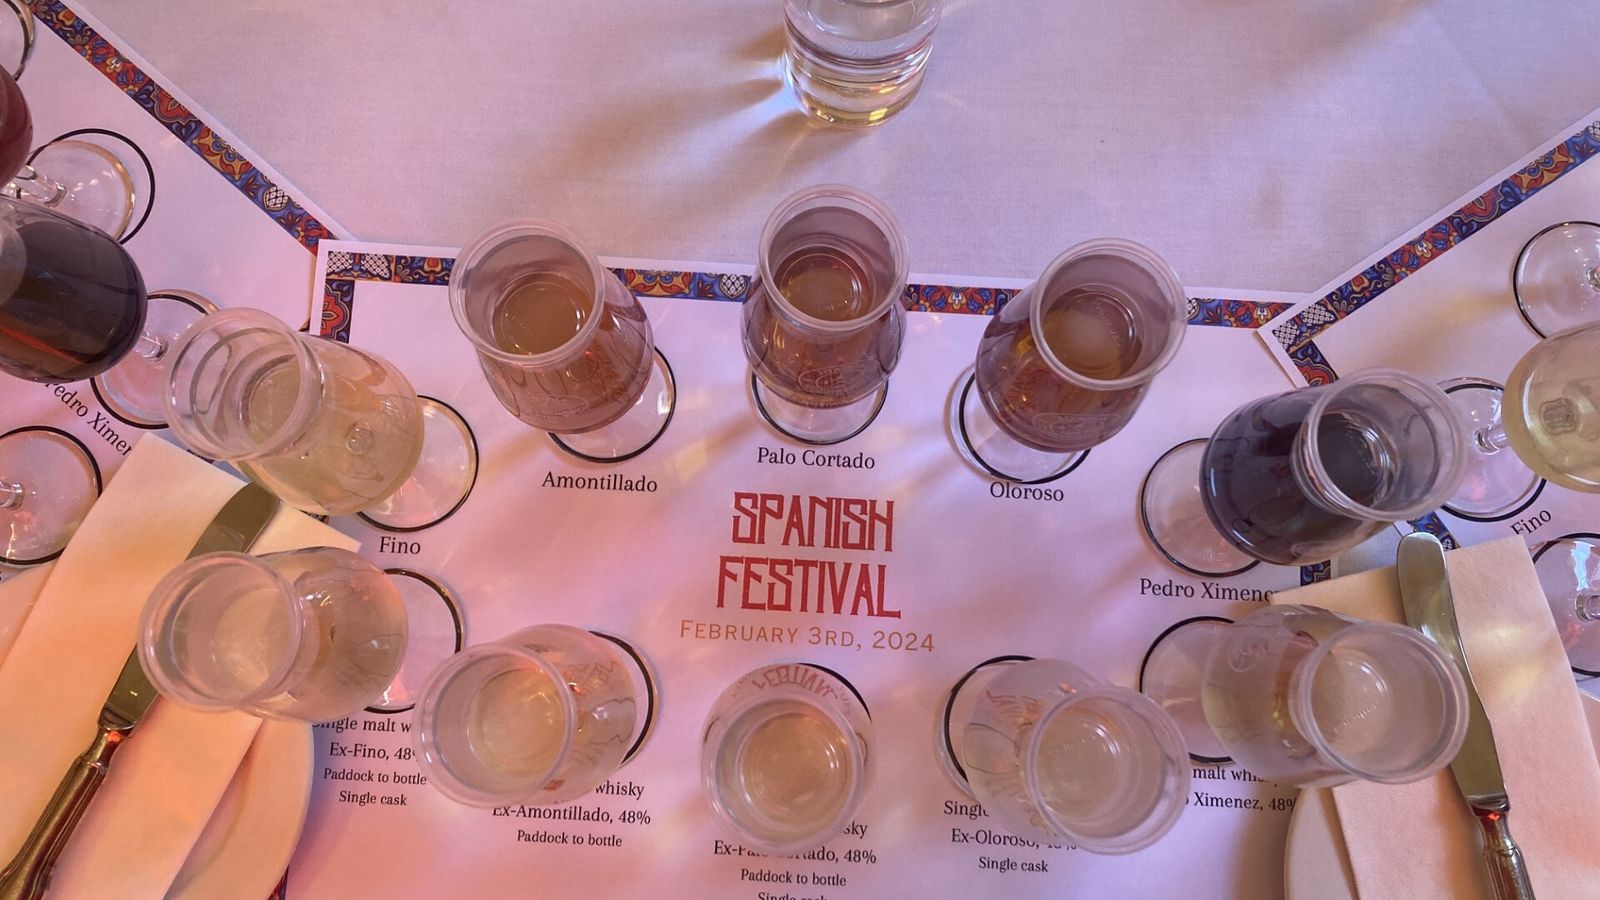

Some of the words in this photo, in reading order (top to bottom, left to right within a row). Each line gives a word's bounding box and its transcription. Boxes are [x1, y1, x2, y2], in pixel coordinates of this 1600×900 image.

[757, 447, 796, 466] Palo
[802, 449, 875, 469] Cortado
[541, 472, 657, 492] Amontillado
[990, 481, 1064, 502] Oloroso
[732, 491, 895, 552] SPANISH
[1510, 509, 1552, 535] Fino
[379, 536, 421, 555] Fino
[716, 555, 902, 619] FESTIVAL
[1140, 578, 1195, 598] Pedro
[1201, 582, 1279, 602] Ximene
[680, 619, 798, 643] FEBRUARY
[808, 626, 862, 651] 3RD,
[872, 630, 935, 652] 2024
[362, 718, 396, 732] malt
[329, 742, 390, 761] Ex-Fino,
[394, 747, 416, 760] 48
[323, 767, 374, 782] Paddock
[377, 772, 389, 783] to
[393, 771, 427, 785] bottle
[1192, 766, 1226, 780] malt
[339, 790, 377, 806] Single
[380, 794, 407, 806] cask
[596, 780, 645, 800] whisky
[1193, 792, 1263, 811] Ximenez,
[618, 809, 651, 825] 48%
[517, 830, 569, 844] Paddock
[572, 834, 584, 845] to
[588, 833, 622, 847] bottle
[843, 849, 877, 864] 48%
[978, 856, 1017, 873] Single
[1021, 860, 1048, 872] cask
[741, 868, 792, 884] Paddock
[796, 874, 808, 885] to
[812, 872, 847, 886] bottle
